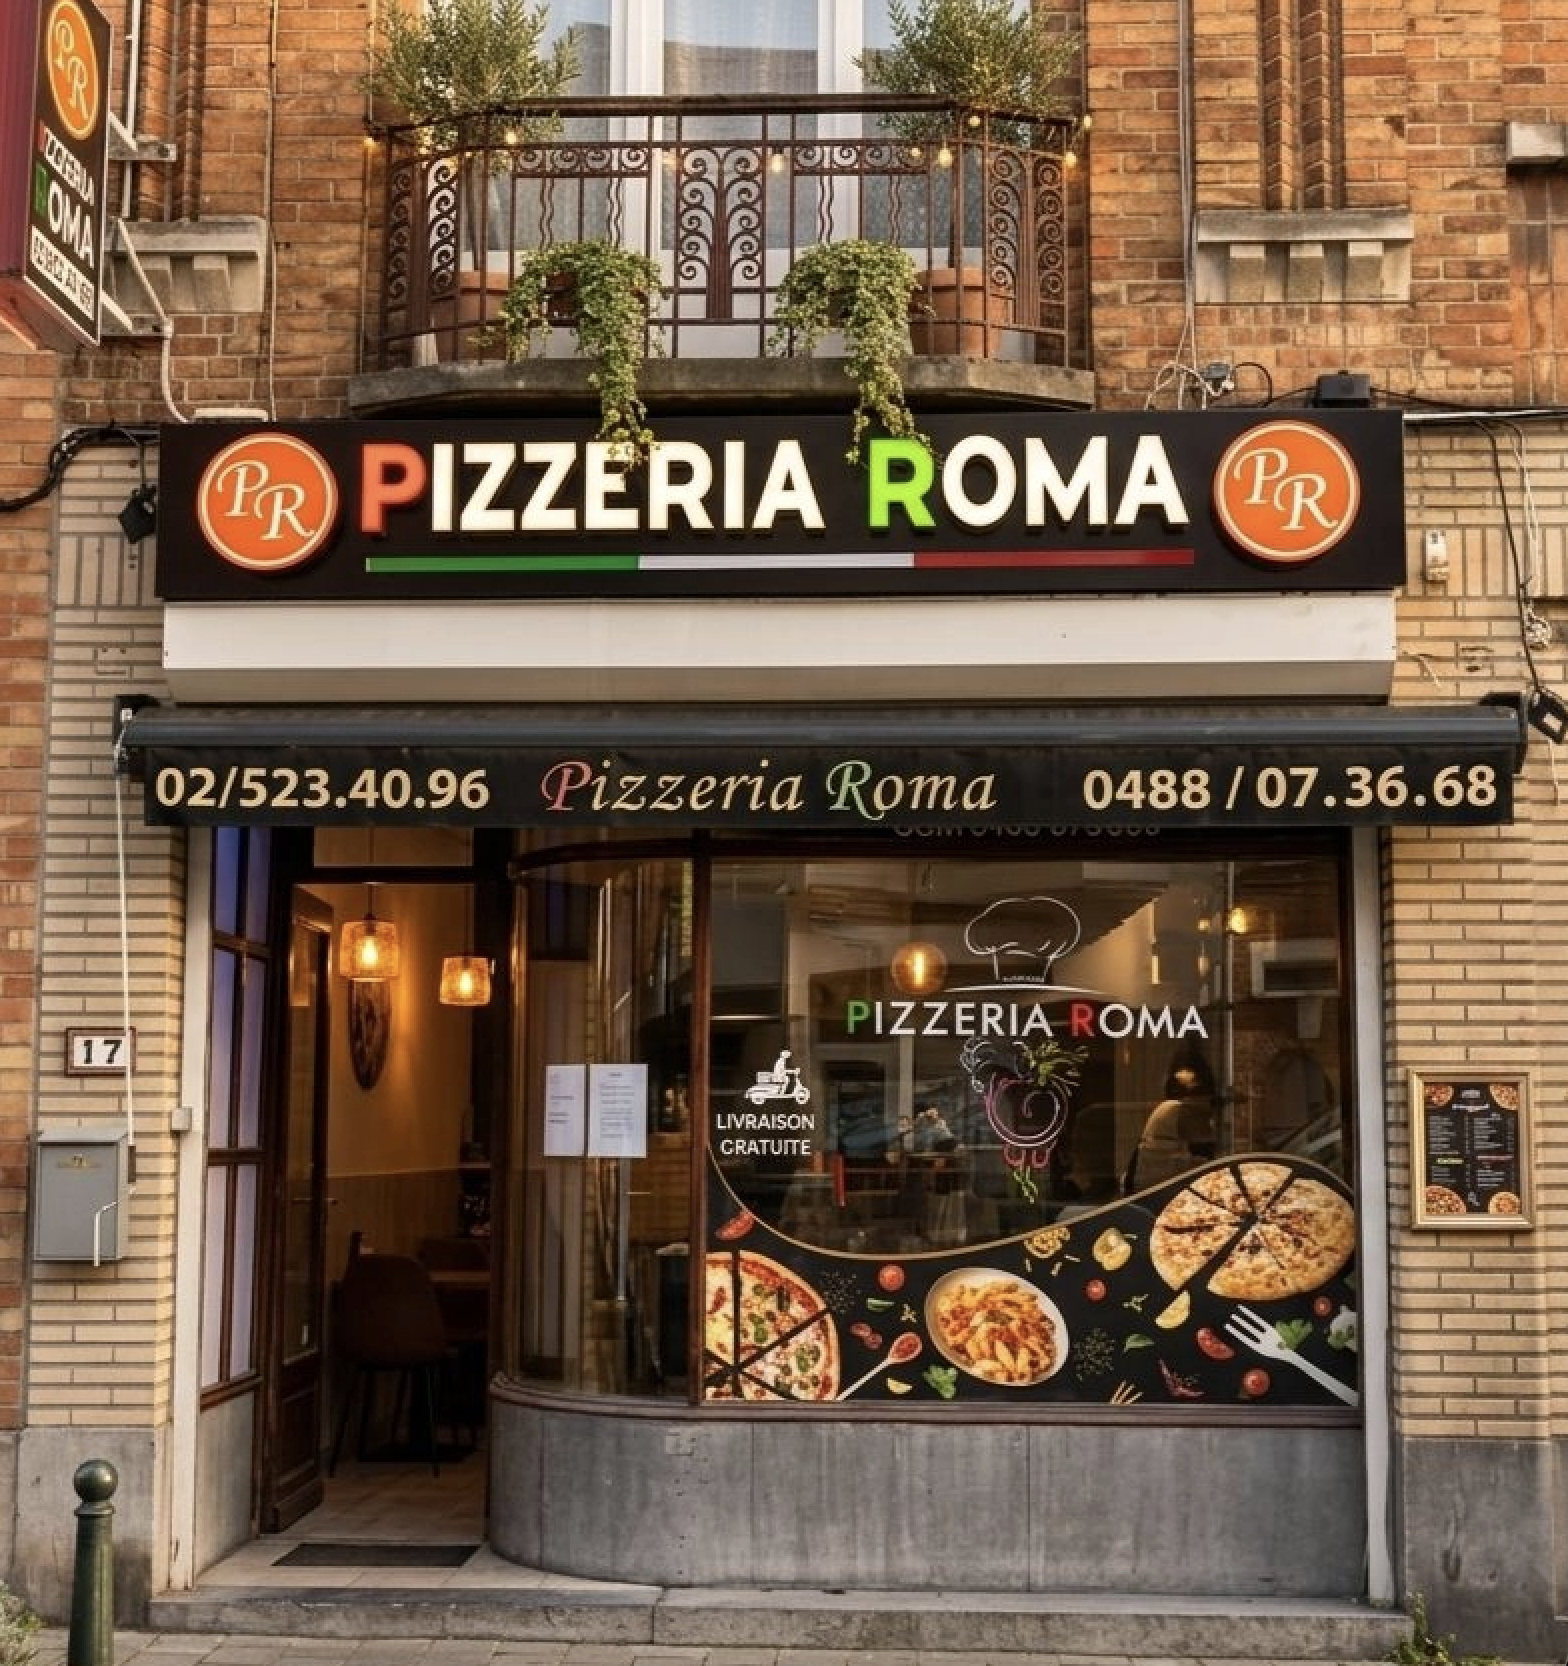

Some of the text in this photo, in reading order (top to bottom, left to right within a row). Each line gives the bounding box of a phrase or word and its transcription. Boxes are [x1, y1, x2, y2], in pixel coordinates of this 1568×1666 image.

[360, 435, 1190, 534] PIZZERIA ROMA
[156, 766, 490, 810] 02/523.40.96
[541, 759, 998, 821] Pizzeria Roma
[1083, 768, 1211, 811] 0488
[1256, 765, 1498, 808] 07.36.68
[847, 999, 1209, 1040] PIZZERIA ROMA
[82, 1039, 123, 1064] 17
[716, 1113, 816, 1131] LIVRAISON
